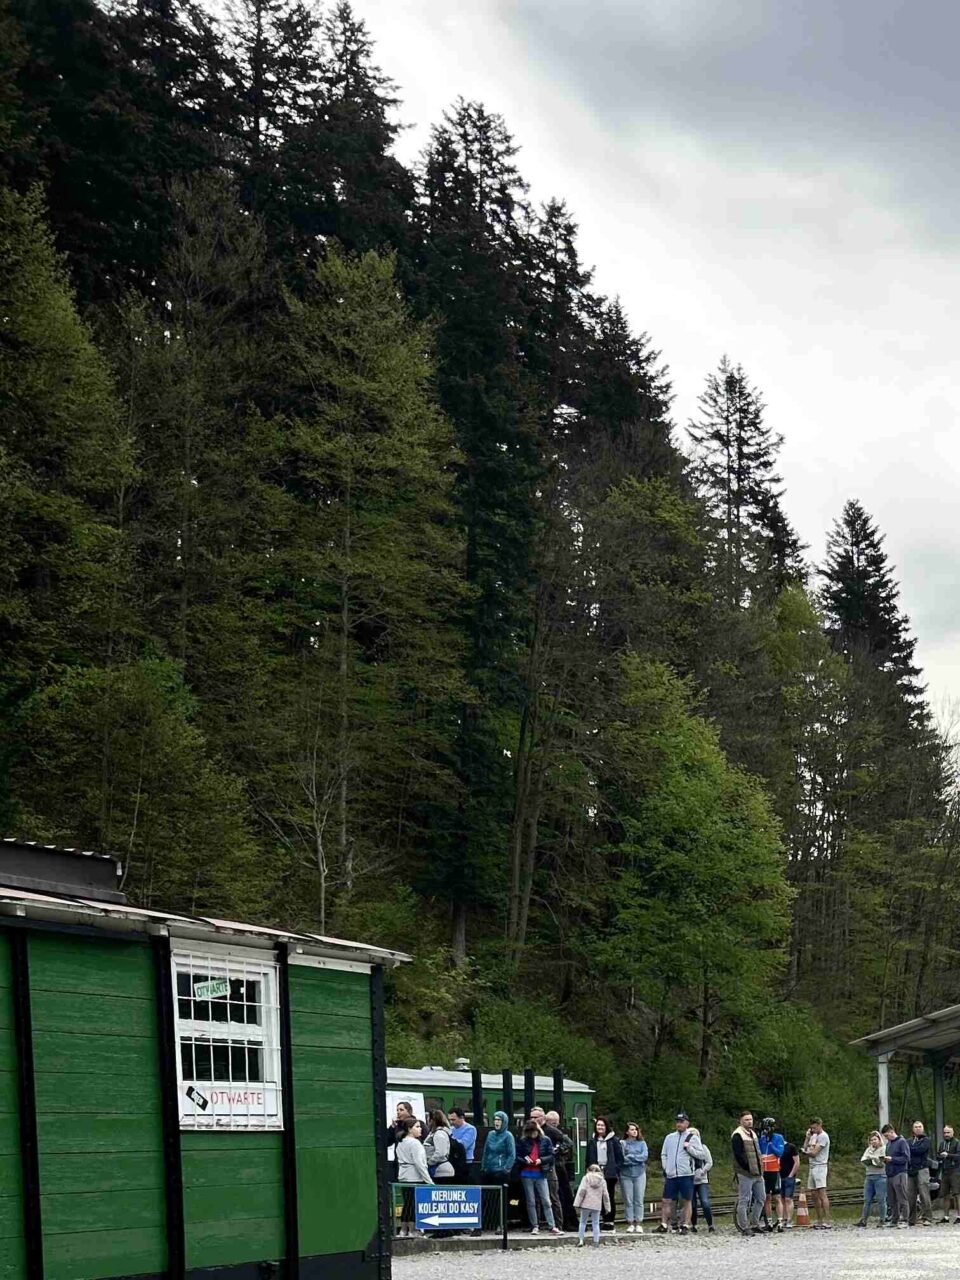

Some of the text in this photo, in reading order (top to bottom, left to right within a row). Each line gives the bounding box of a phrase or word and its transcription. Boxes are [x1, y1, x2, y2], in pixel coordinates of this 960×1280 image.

[196, 981, 229, 998] OTWARTE
[210, 1091, 263, 1105] OTWARTE
[431, 1190, 467, 1201] KIERUNEK
[418, 1202, 479, 1213] KOLEJKI DO KASY
